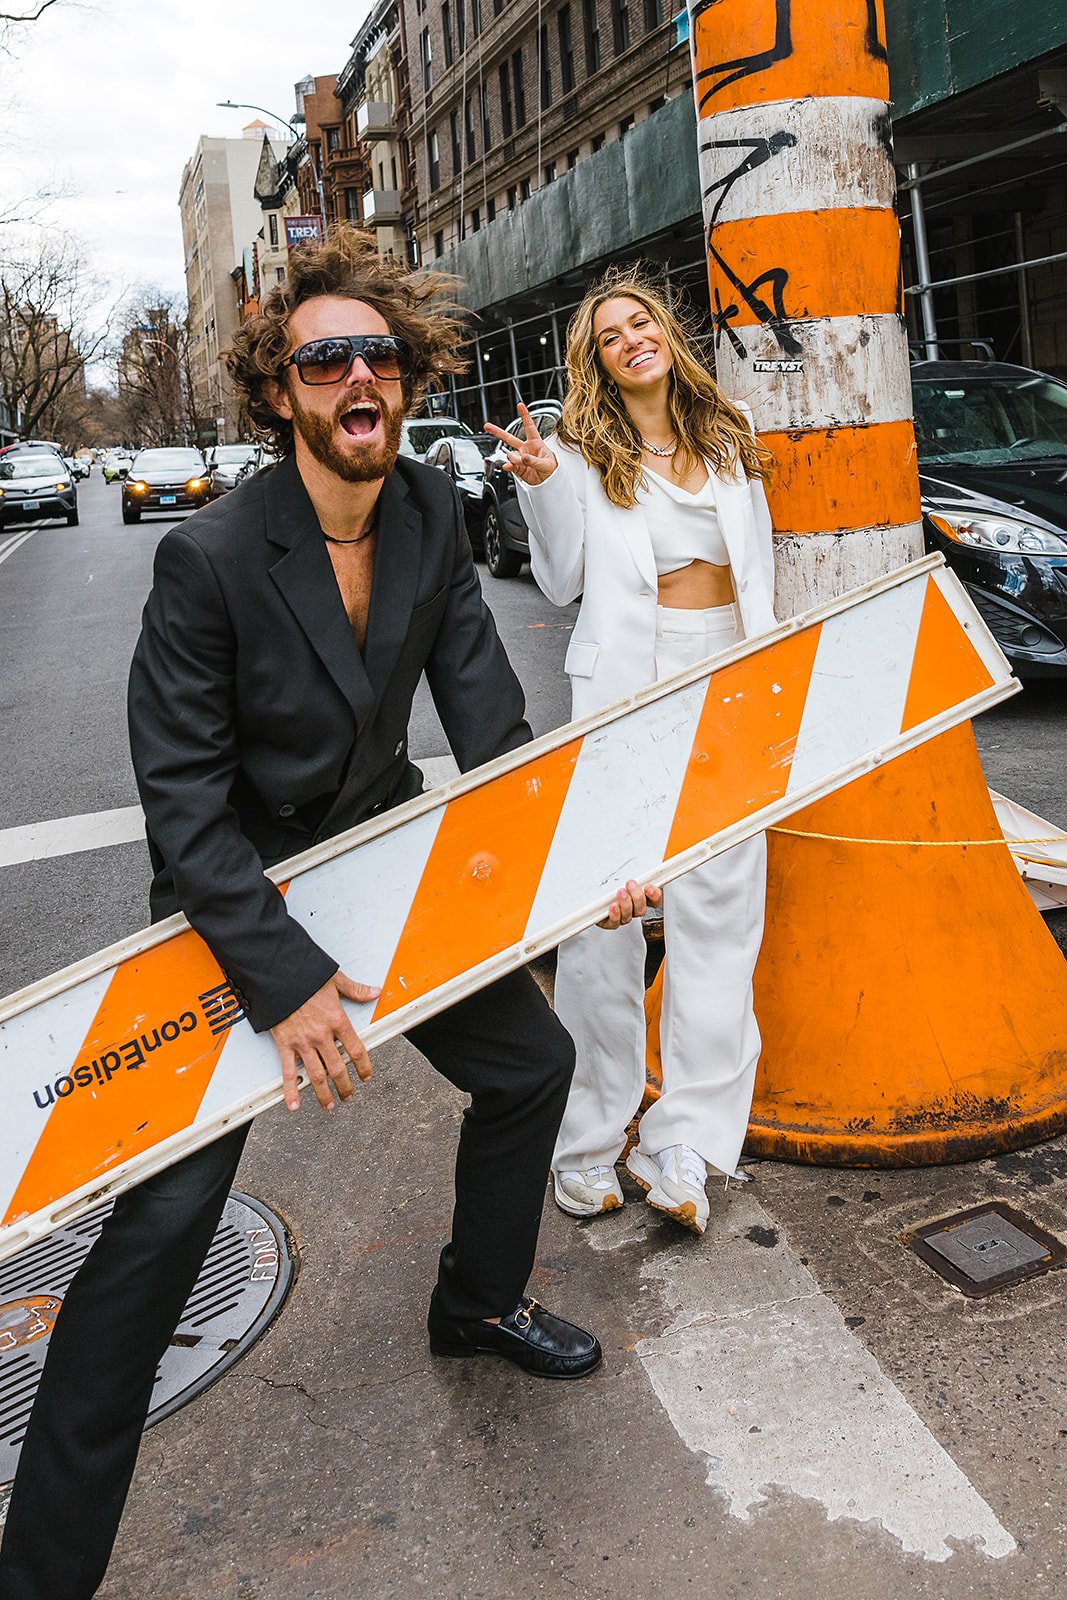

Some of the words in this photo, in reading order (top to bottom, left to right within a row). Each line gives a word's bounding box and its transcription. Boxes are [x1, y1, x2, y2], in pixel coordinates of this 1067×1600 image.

[287, 226, 318, 238] T.REX
[32, 1011, 198, 1109] conEdison
[245, 1227, 278, 1282] FDNY
